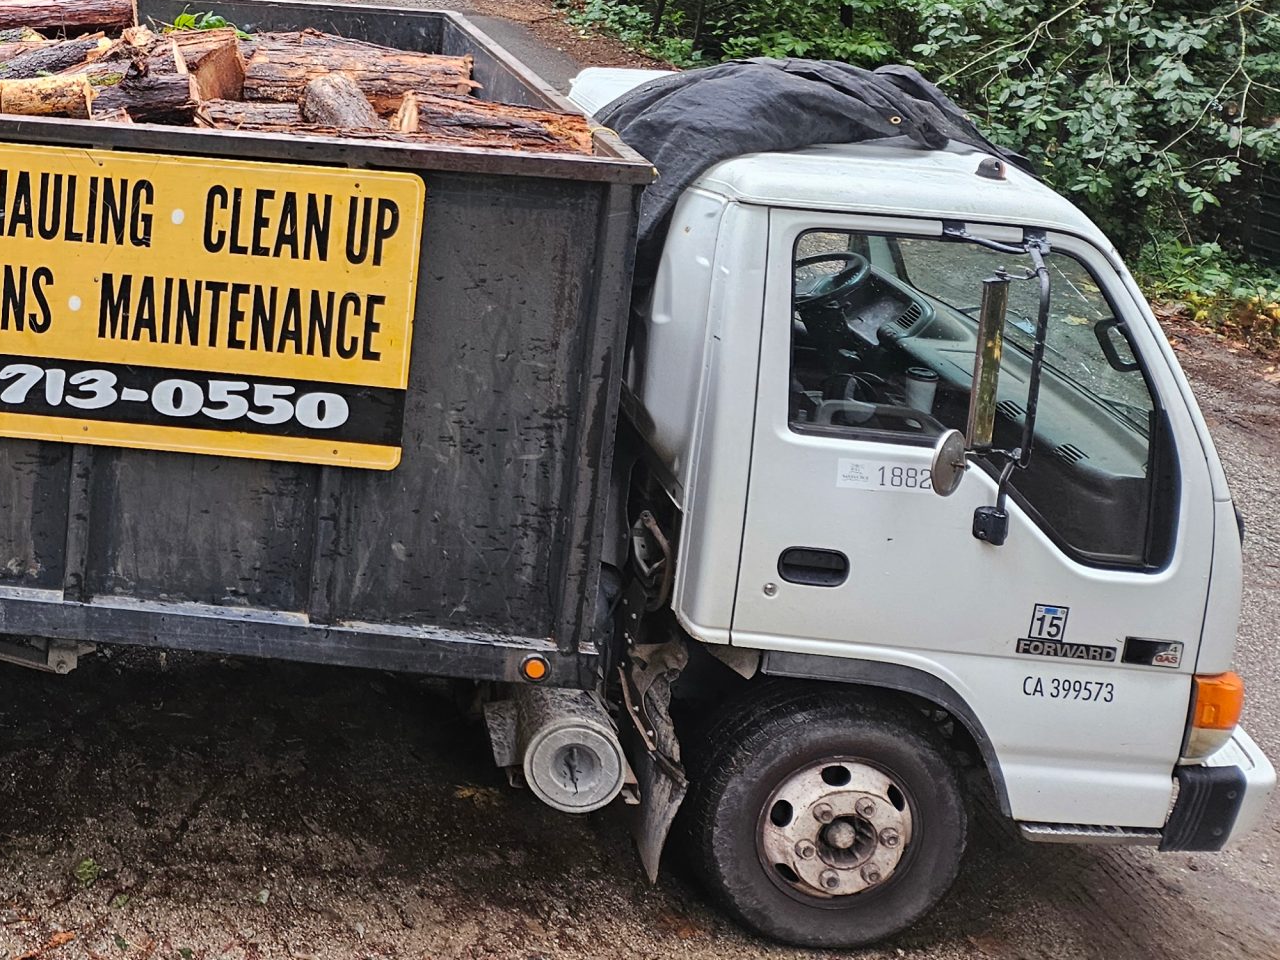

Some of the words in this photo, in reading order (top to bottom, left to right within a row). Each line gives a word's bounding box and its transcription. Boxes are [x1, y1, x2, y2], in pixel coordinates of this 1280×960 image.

[203, 184, 333, 262] CLEAN
[345, 195, 400, 267] UP
[97, 272, 386, 362] MAINTENANCE
[1036, 614, 1063, 638] 15
[1018, 641, 1116, 661] FORWARD
[1154, 654, 1179, 664] GAS
[1022, 675, 1044, 697] CA
[1050, 678, 1114, 703] 399573
